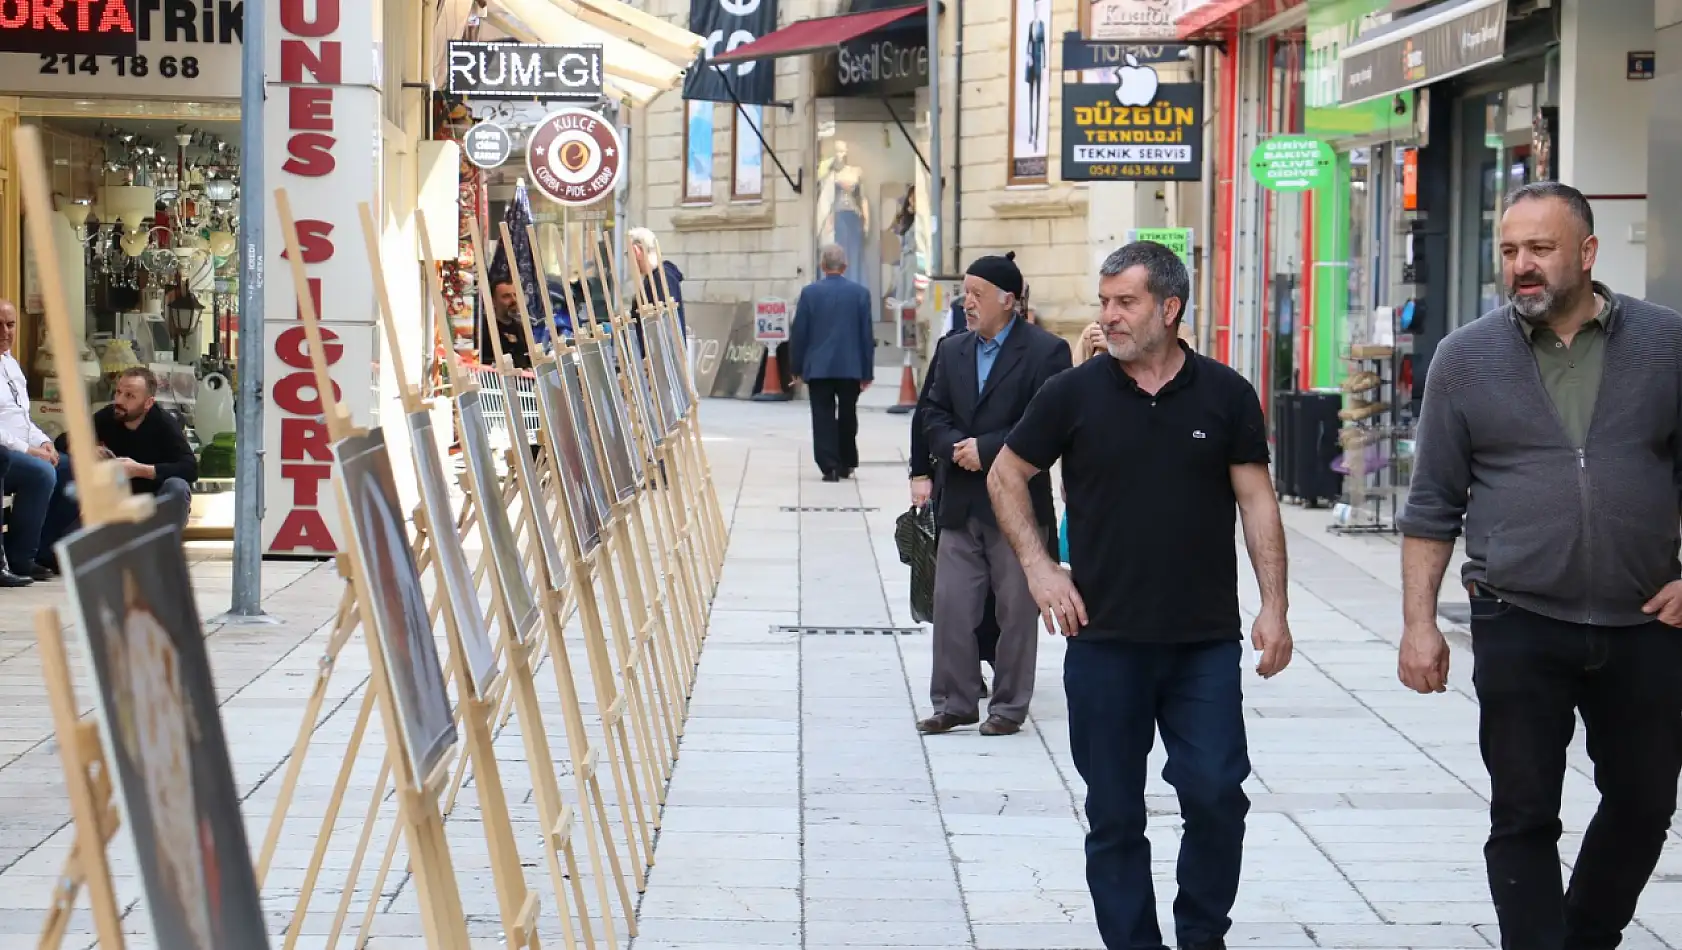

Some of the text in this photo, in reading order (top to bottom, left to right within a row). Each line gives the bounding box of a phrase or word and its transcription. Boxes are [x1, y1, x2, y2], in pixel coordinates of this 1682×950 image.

[0, 0, 134, 32] ORTA
[40, 54, 200, 79] 214 18 68
[1073, 101, 1194, 125] DÜZGÜN
[1084, 127, 1182, 143] TEKNOLOJİ
[1079, 148, 1132, 159] TEKNİK
